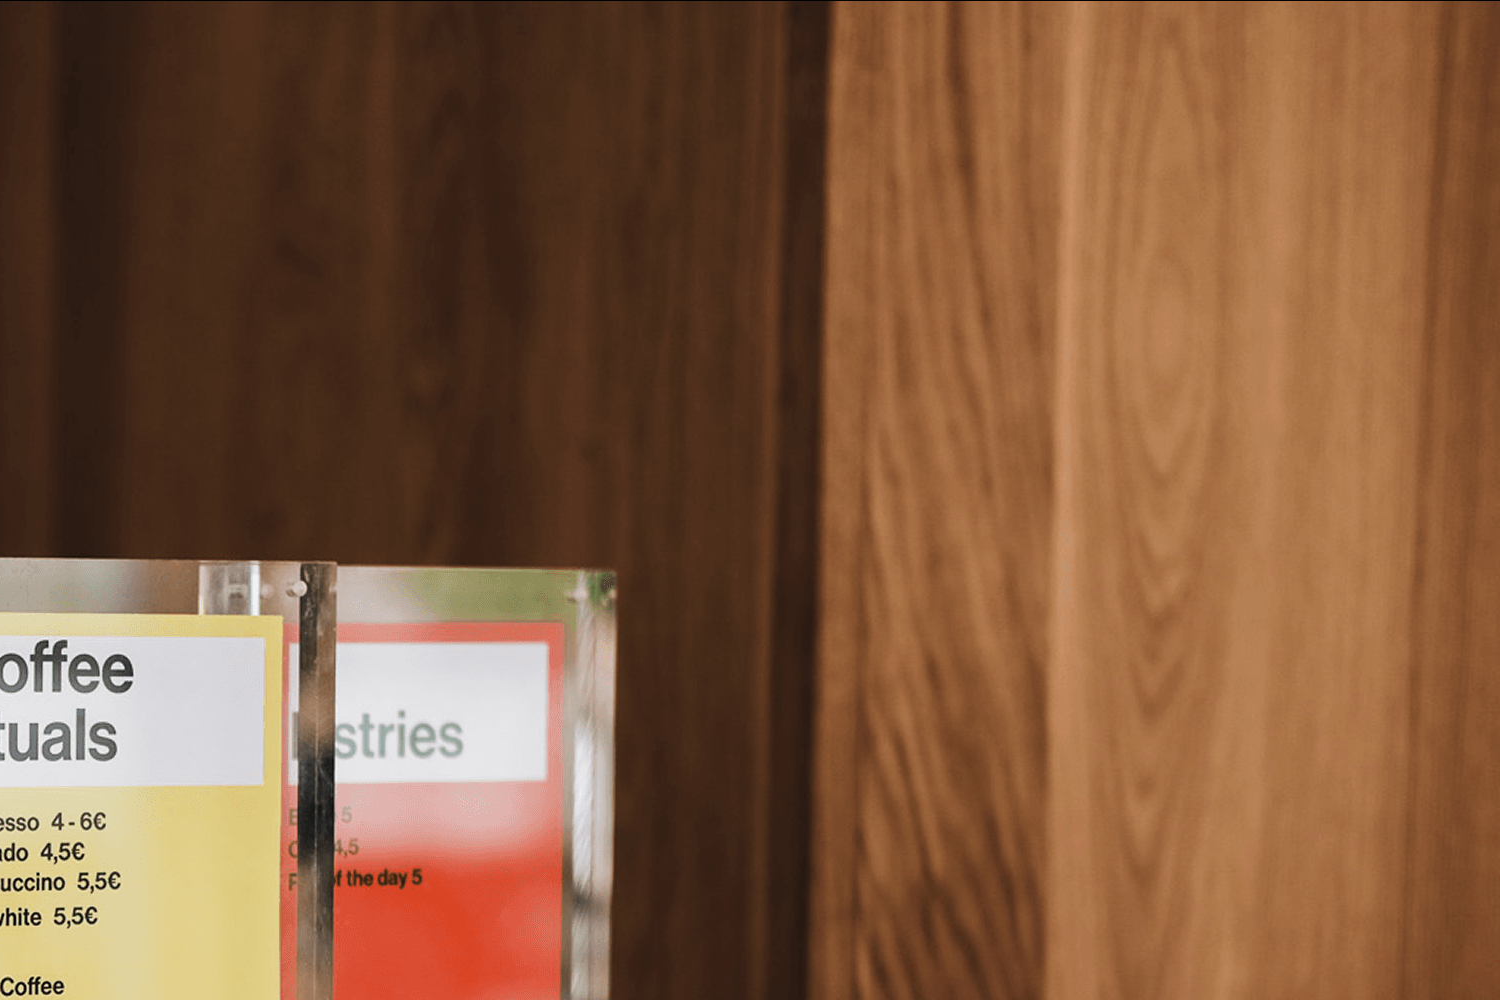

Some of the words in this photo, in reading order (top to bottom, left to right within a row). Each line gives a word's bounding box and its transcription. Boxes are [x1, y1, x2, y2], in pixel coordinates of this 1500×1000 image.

[292, 710, 464, 760] stries
[40, 842, 85, 865] 4,5€
[77, 871, 121, 894] 5,5€
[346, 869, 374, 887] the
[377, 868, 408, 890] day
[411, 868, 423, 886] 5
[53, 906, 98, 929] 5,5€
[0, 976, 65, 997] Coffee
